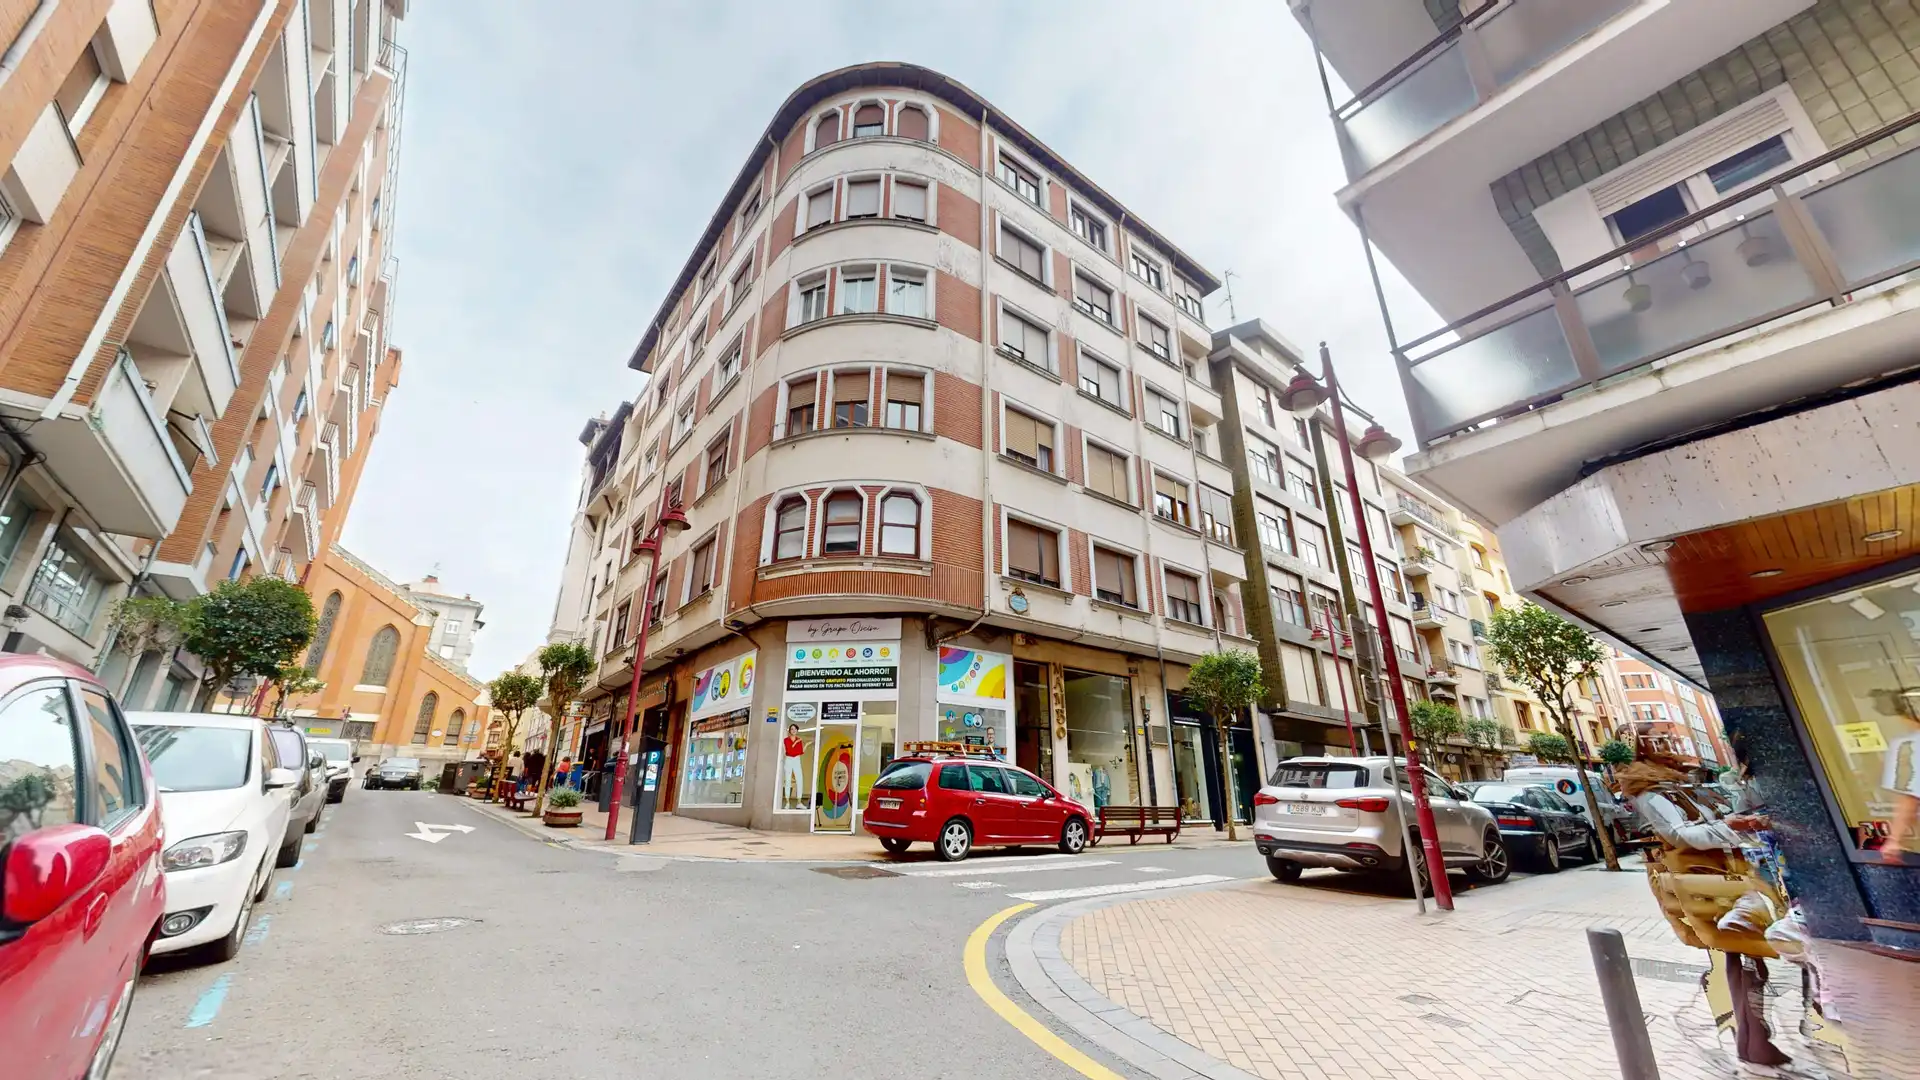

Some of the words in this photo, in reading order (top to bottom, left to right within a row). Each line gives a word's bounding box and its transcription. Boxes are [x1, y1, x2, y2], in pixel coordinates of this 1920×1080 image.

[807, 624, 818, 638] by
[821, 622, 847, 637] Grupo
[853, 667, 890, 675] AHORRO!!
[650, 751, 658, 762] P
